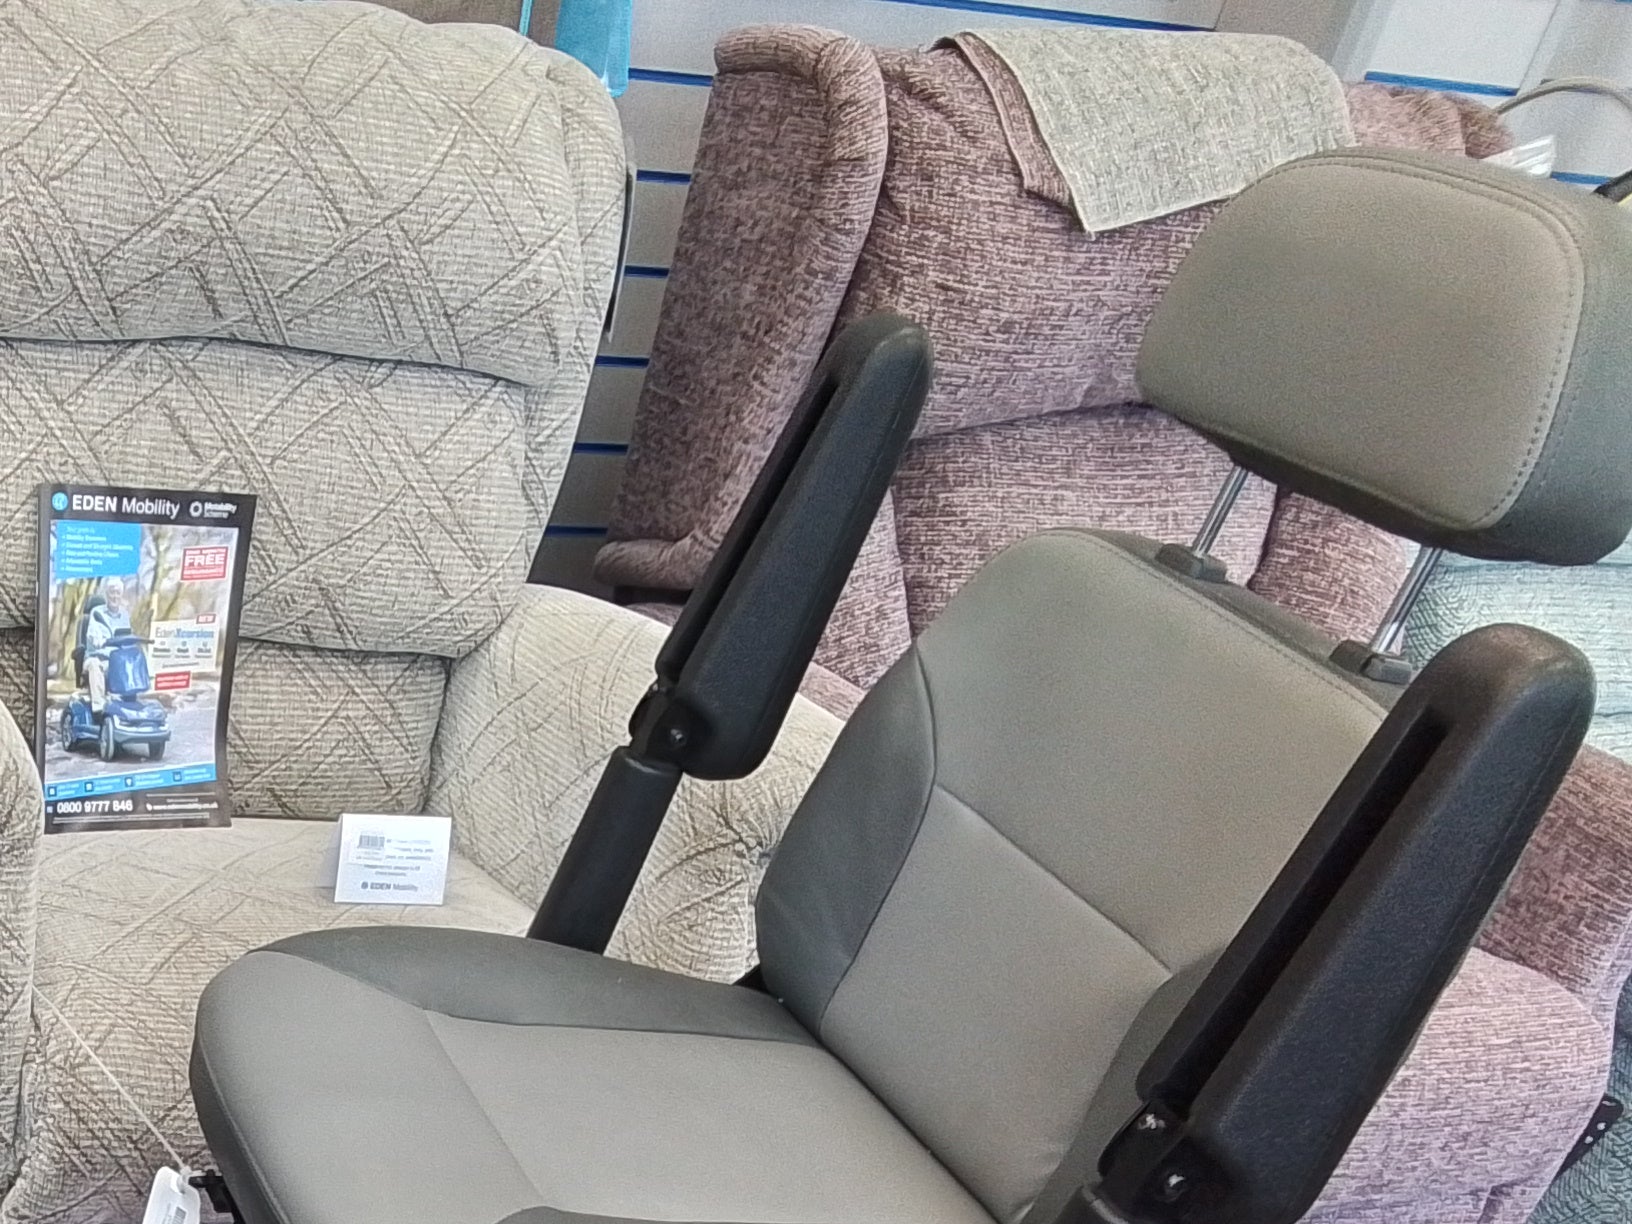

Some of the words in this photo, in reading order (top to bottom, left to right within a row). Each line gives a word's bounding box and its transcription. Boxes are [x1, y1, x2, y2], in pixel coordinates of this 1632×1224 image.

[72, 494, 117, 512] EDEN
[122, 497, 180, 520] Mobility
[185, 553, 225, 567] FREE
[56, 801, 82, 814] 0800
[84, 801, 110, 813] 9777
[113, 799, 133, 812] 846
